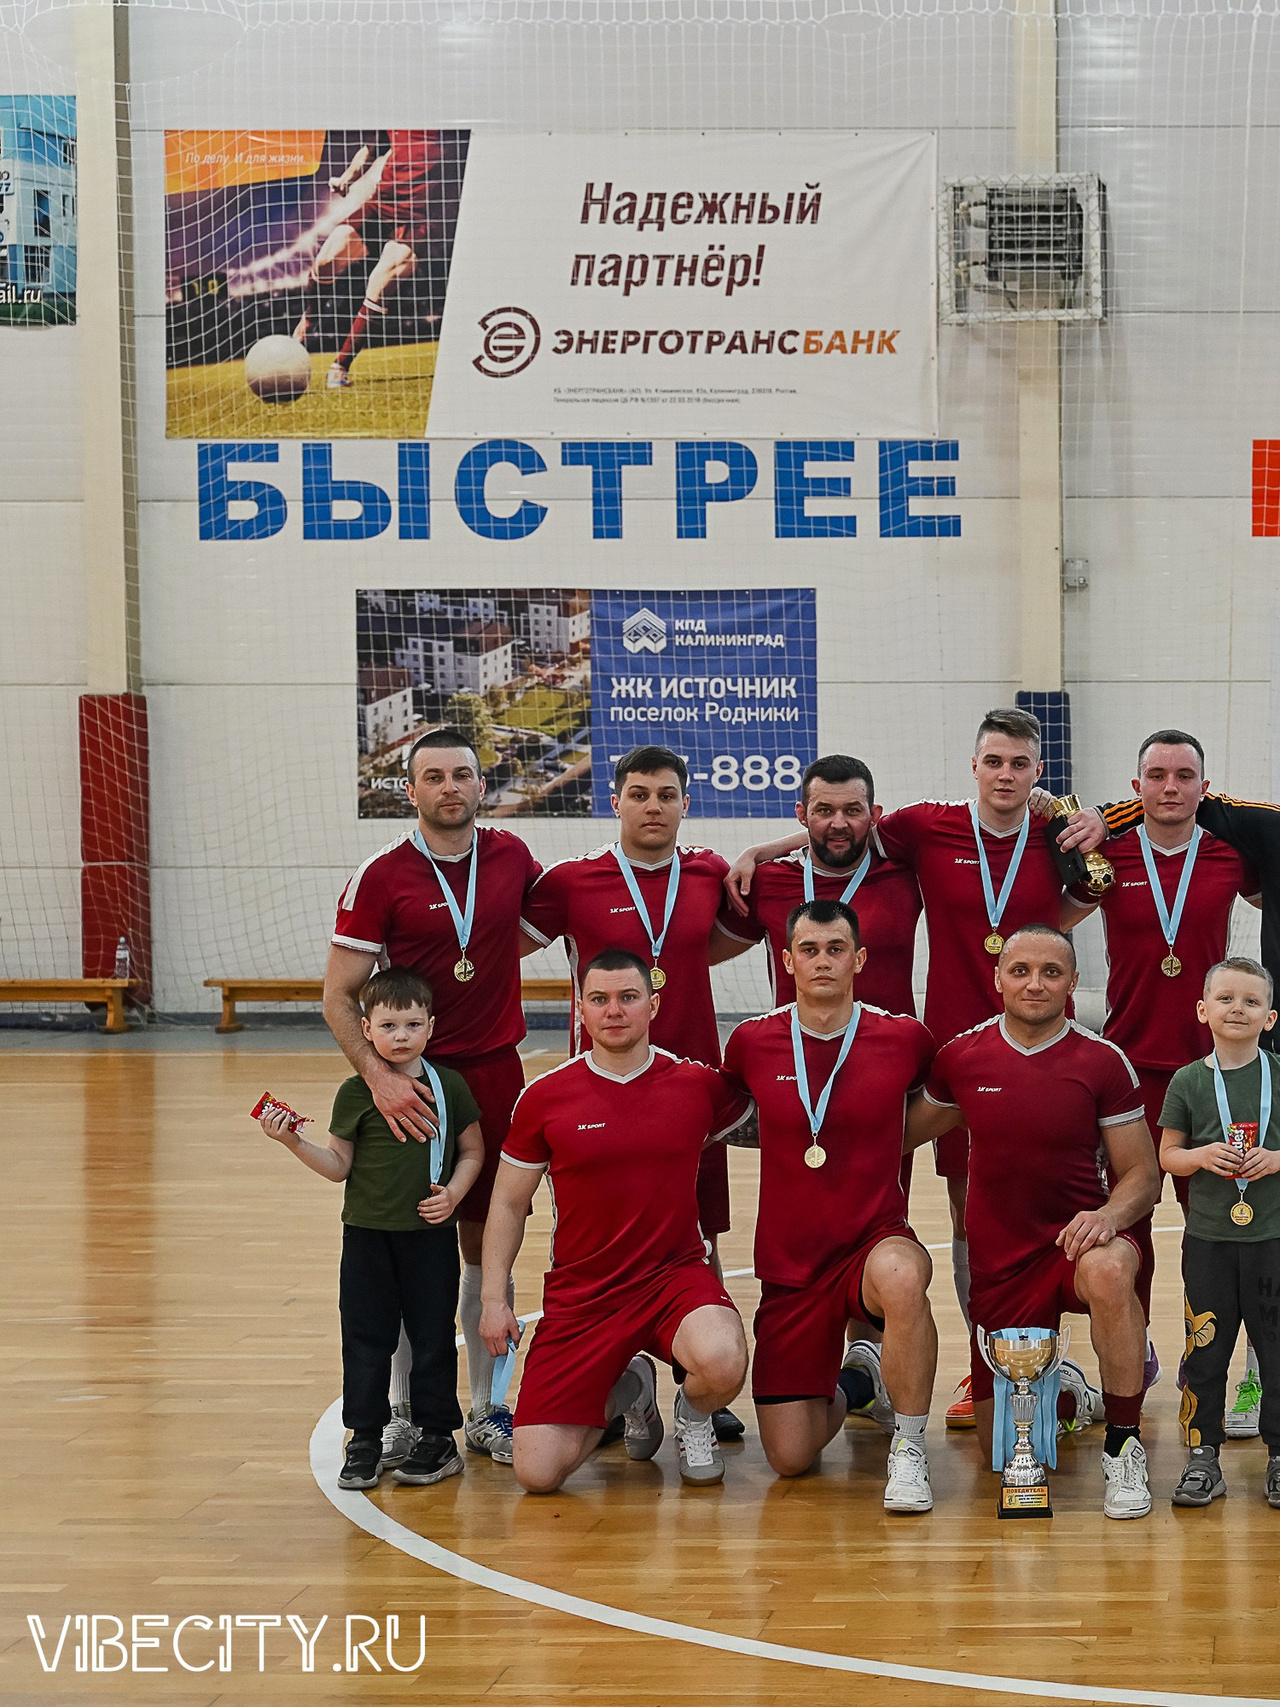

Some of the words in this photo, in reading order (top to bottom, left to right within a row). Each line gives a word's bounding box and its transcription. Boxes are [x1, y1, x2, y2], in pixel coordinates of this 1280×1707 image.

[580, 182, 823, 231] Надежный
[570, 245, 766, 296] партнёр!
[551, 329, 901, 355] ЭНЕРГОТРАНСБАНК
[197, 439, 962, 541] БЫСТРЕЕ
[675, 619, 707, 633] КПД
[675, 634, 785, 648] КАЛИНИНГРАД
[610, 677, 653, 699] ЖК
[661, 677, 797, 699] ИСТОЧНИК
[610, 706, 698, 722] поселок
[705, 702, 799, 725] Родники
[371, 777, 408, 790] ИСТО
[608, 755, 801, 791] -888
